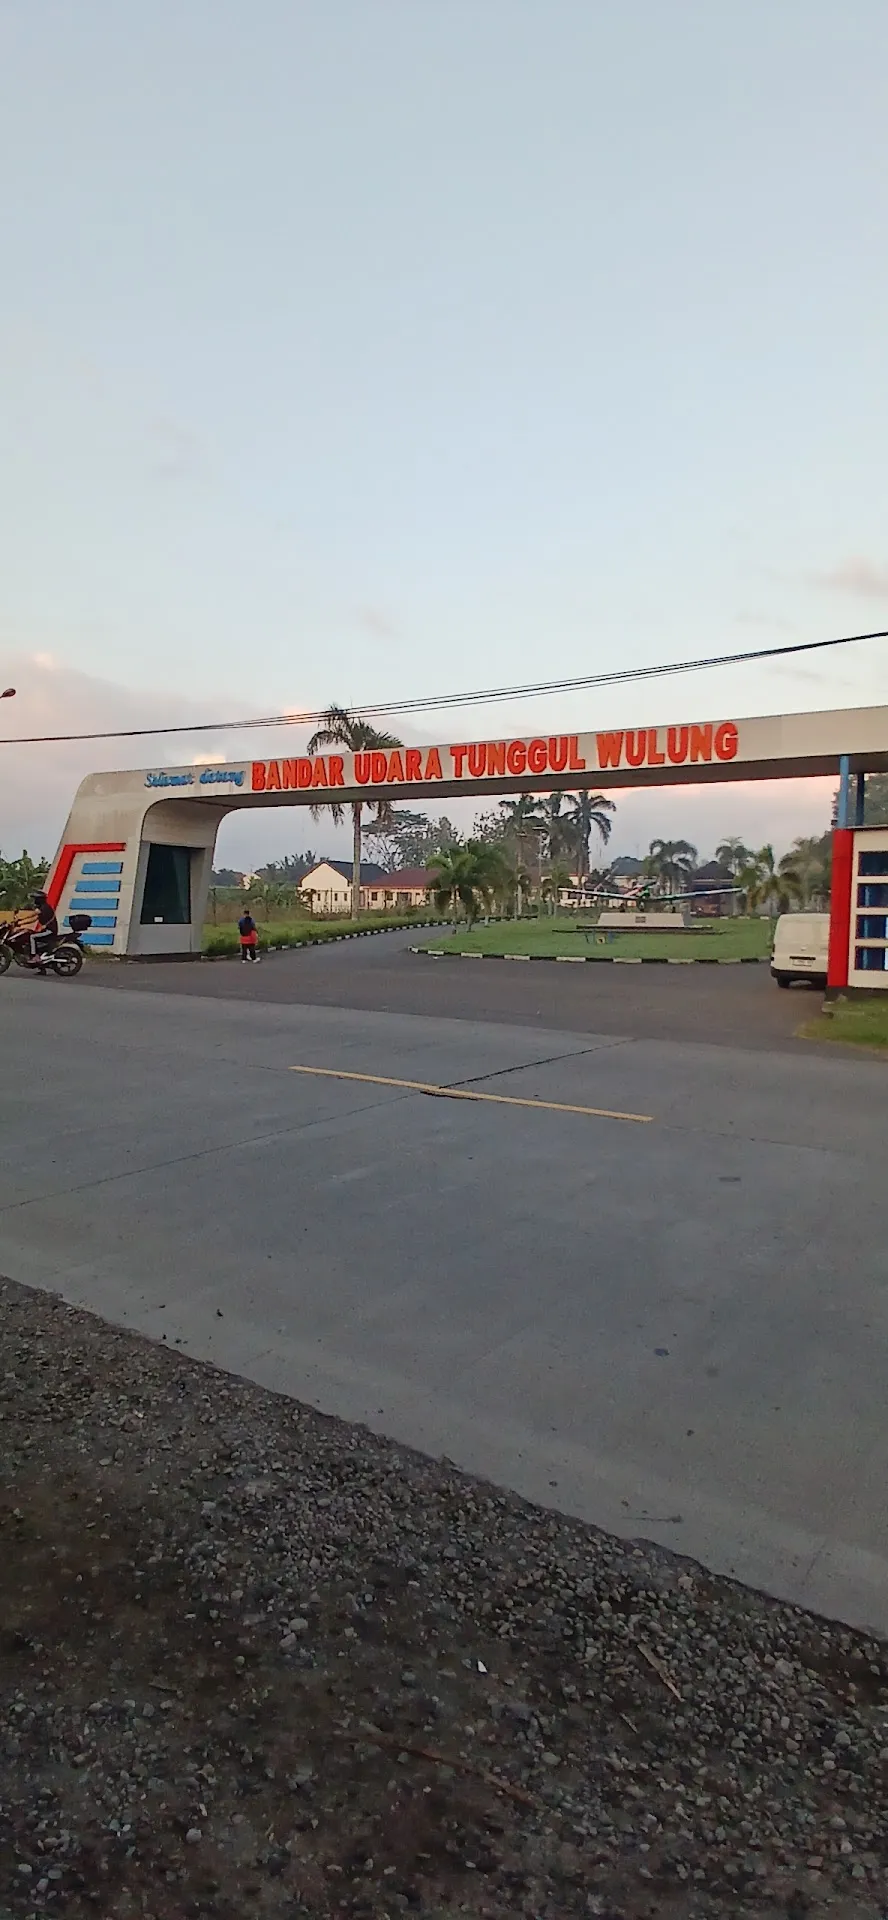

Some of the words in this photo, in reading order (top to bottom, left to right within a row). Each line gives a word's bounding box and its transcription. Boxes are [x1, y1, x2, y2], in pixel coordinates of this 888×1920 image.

[251, 755, 345, 792] BANDAR
[353, 747, 443, 785] UDARA
[449, 736, 586, 779] TUNGGUL
[596, 721, 740, 769] WULUNG
